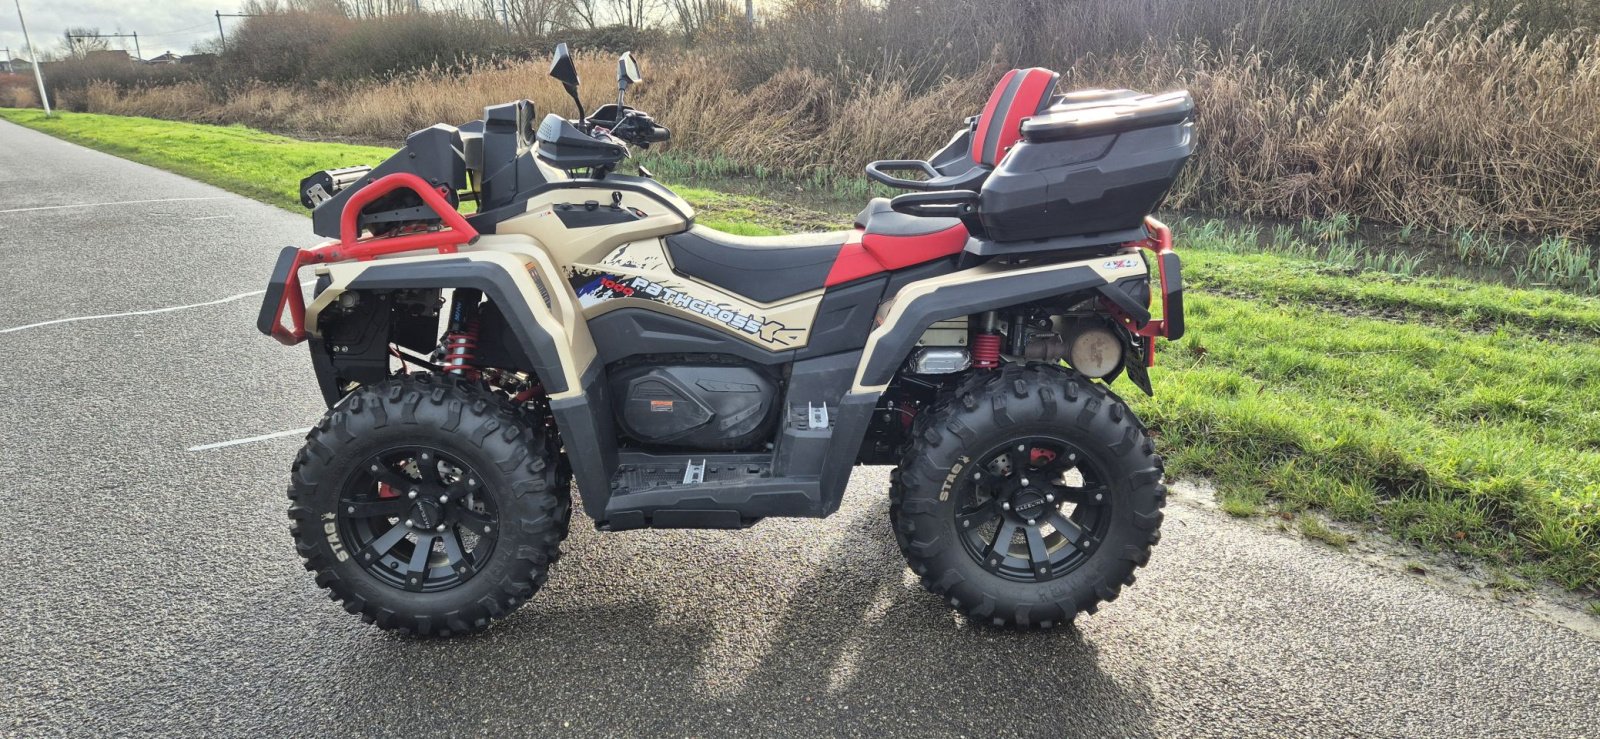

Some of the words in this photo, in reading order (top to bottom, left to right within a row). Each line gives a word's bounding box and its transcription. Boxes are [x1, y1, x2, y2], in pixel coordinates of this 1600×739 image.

[600, 277, 635, 297] 1000
[939, 463, 964, 502] STAG
[324, 521, 350, 562] STAG
